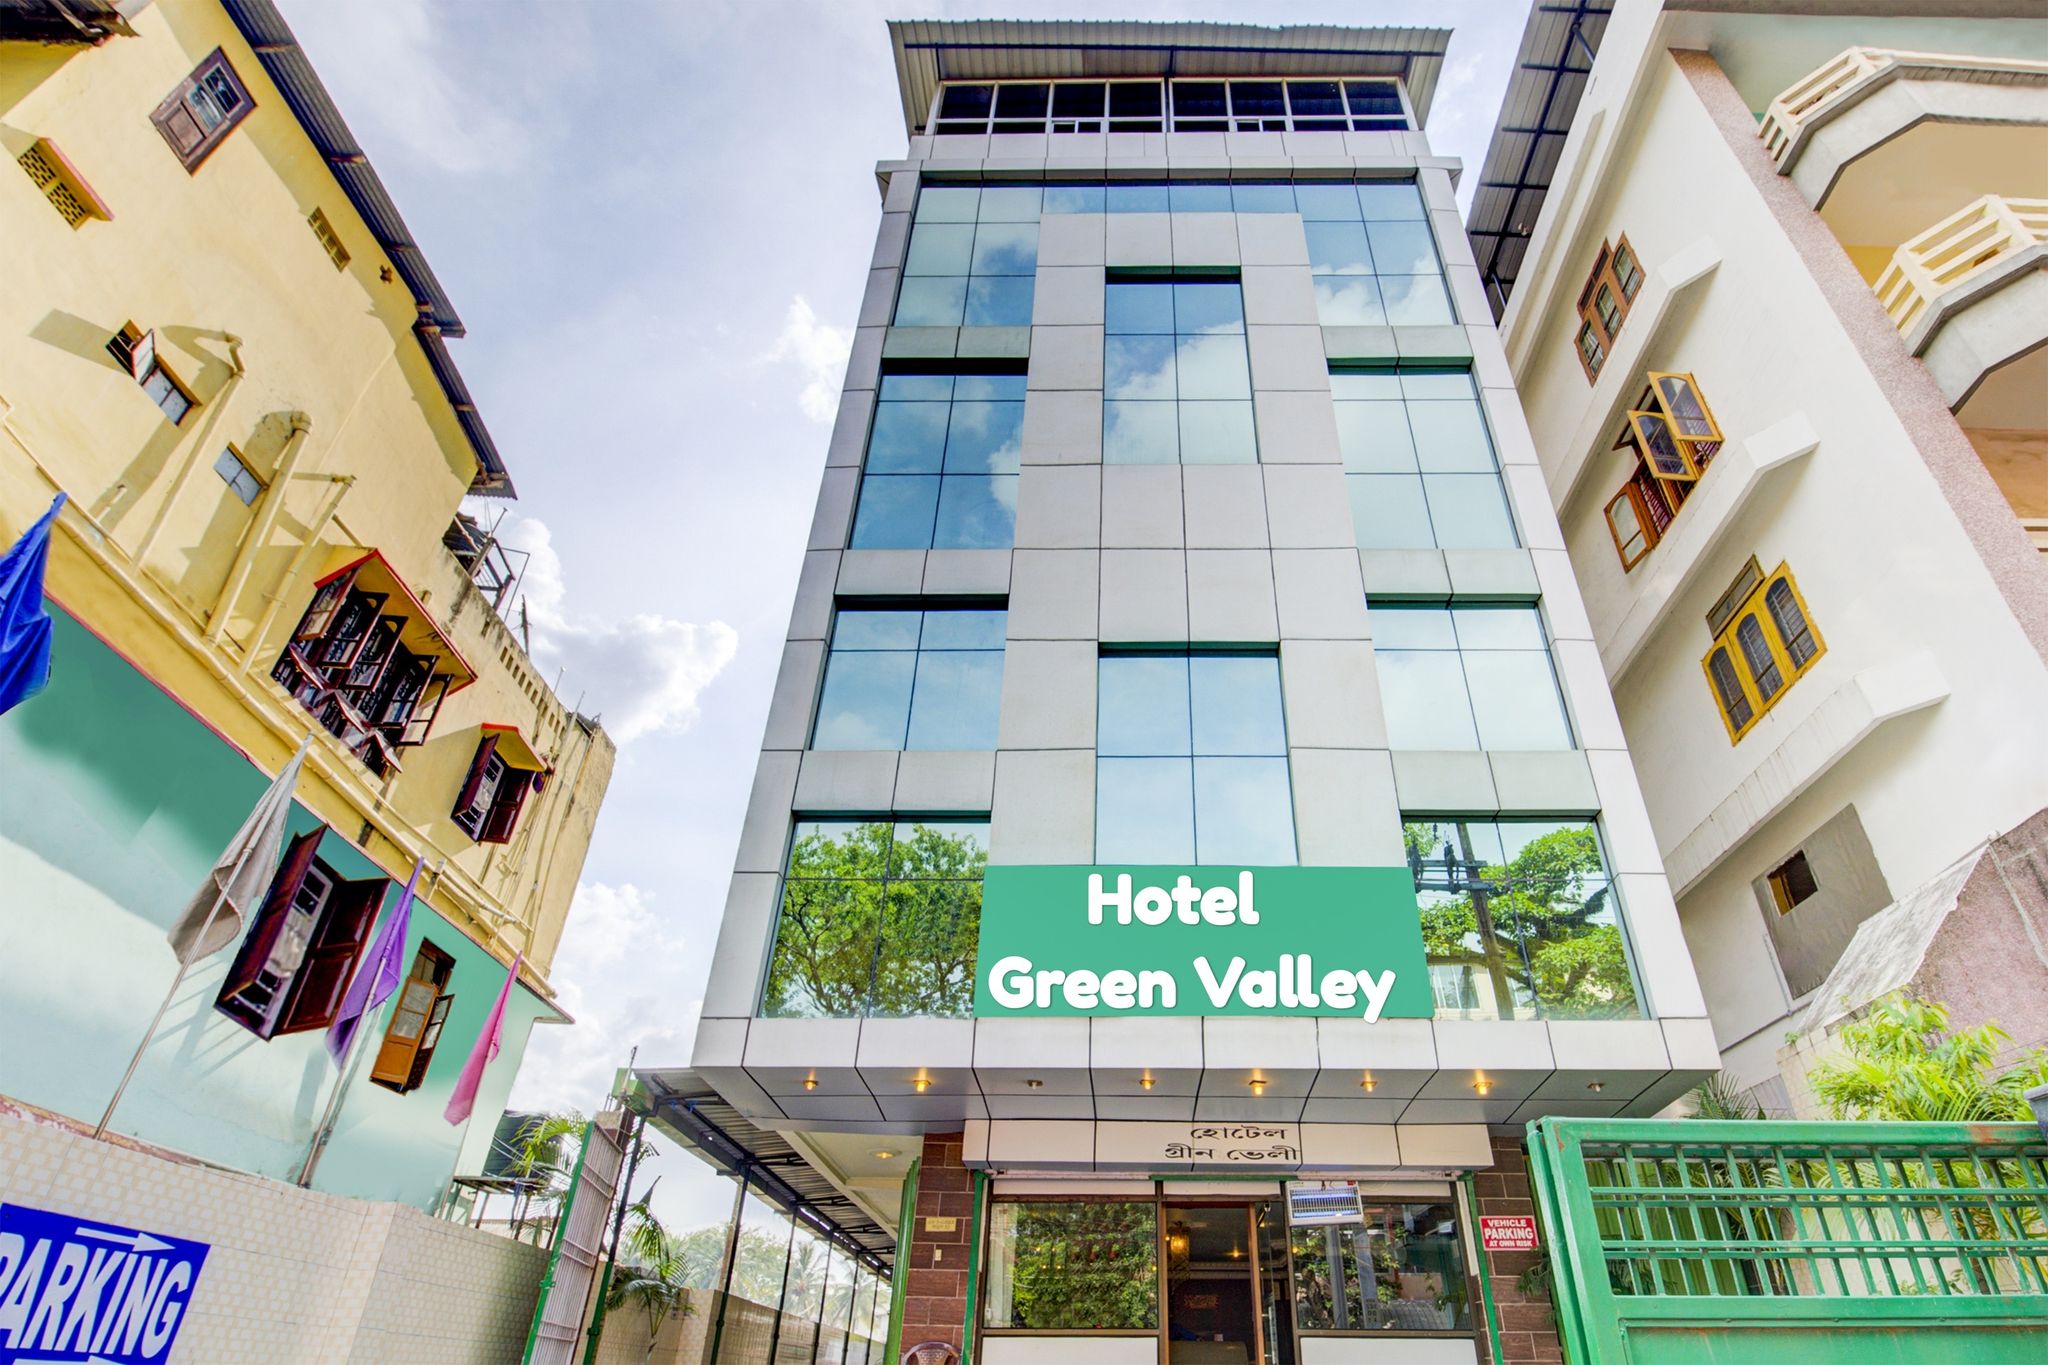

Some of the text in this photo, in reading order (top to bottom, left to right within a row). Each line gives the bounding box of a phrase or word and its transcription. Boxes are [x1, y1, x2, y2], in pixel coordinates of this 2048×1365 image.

[1088, 871, 1260, 926] Hotel
[988, 954, 1397, 1024] Green Valley
[1191, 1125, 1288, 1140] হোটেল
[1487, 1219, 1527, 1228] VEHICLE
[1484, 1227, 1534, 1240] PARKING
